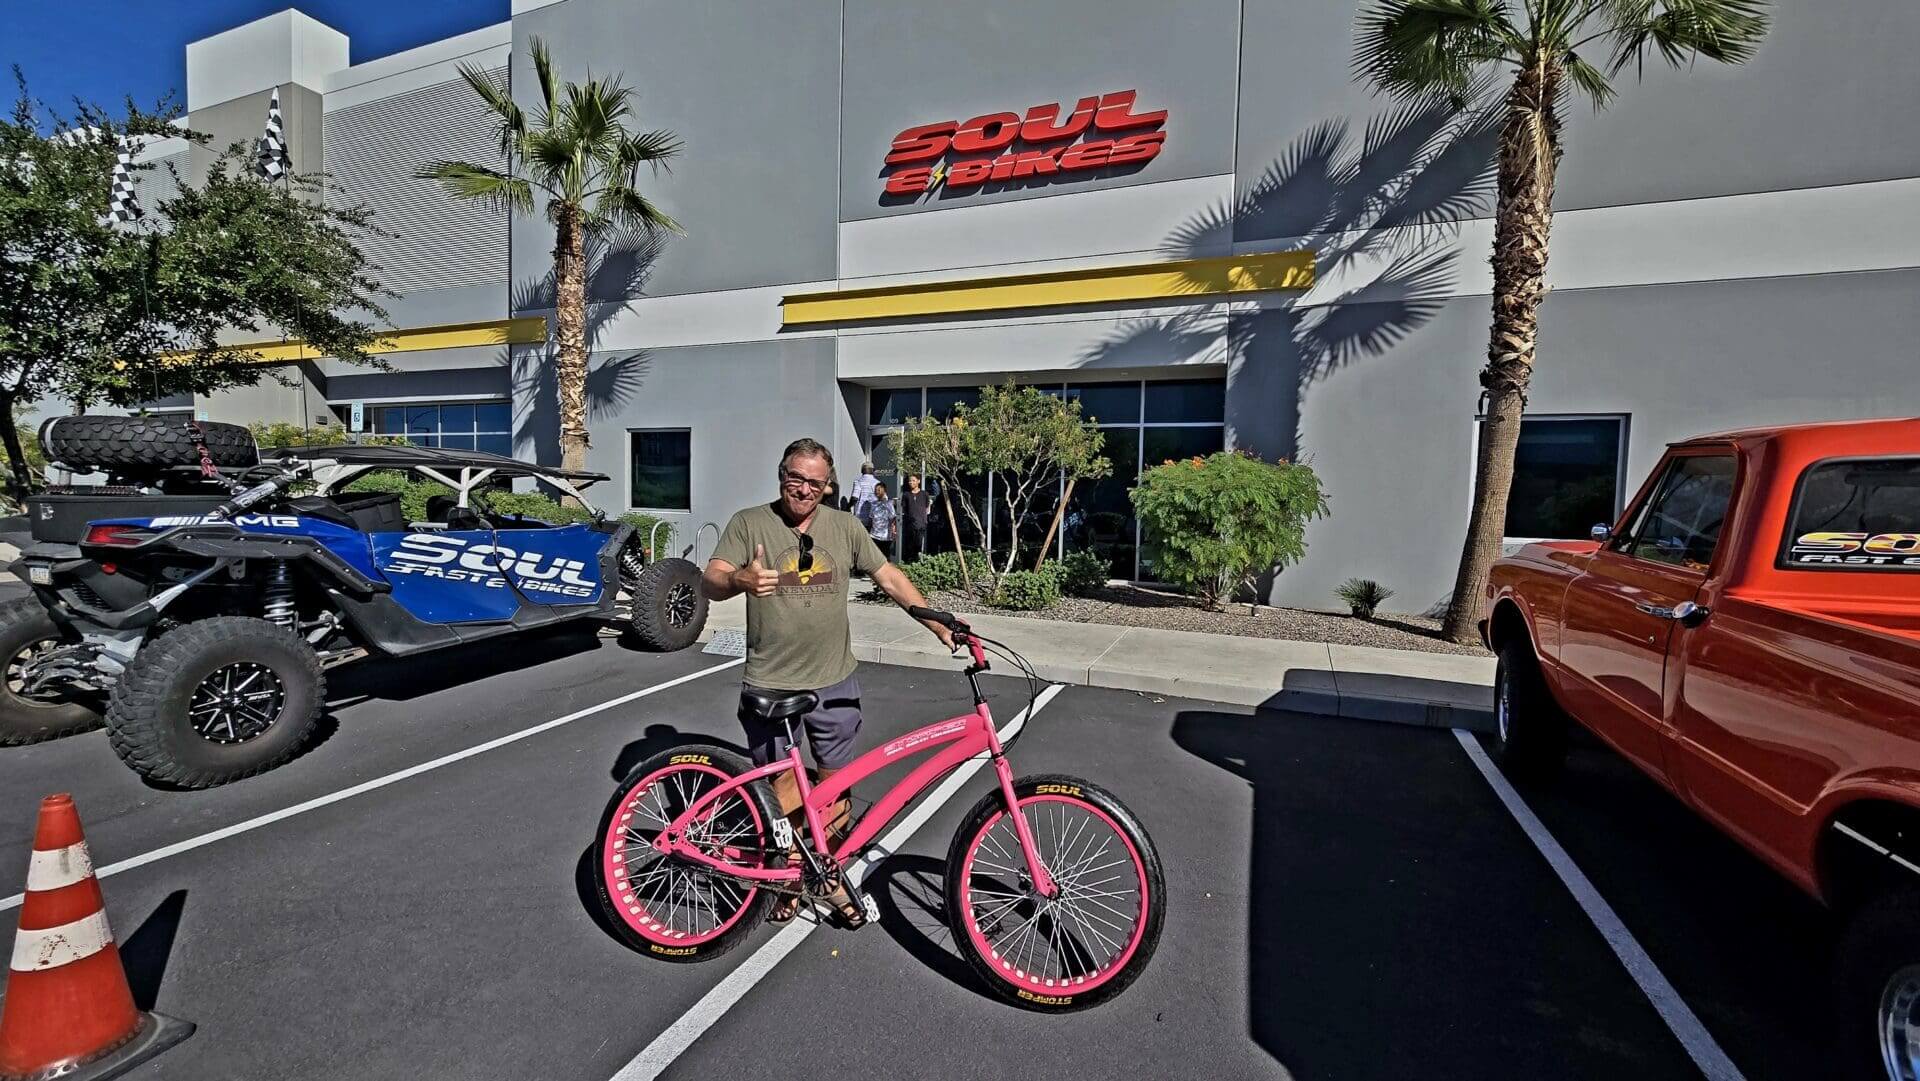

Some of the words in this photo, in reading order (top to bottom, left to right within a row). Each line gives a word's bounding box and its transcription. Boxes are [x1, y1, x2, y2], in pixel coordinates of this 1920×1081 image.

[884, 89, 1168, 166] SOUL
[390, 534, 597, 588] SOUL
[1800, 555, 1893, 565] FAST
[384, 561, 484, 583] FAST
[780, 585, 833, 594] NEVADA
[669, 754, 712, 766] SOUL
[1036, 784, 1084, 798] SOUL
[650, 944, 698, 956] STOMPER
[1017, 989, 1073, 1005] STOMPER
